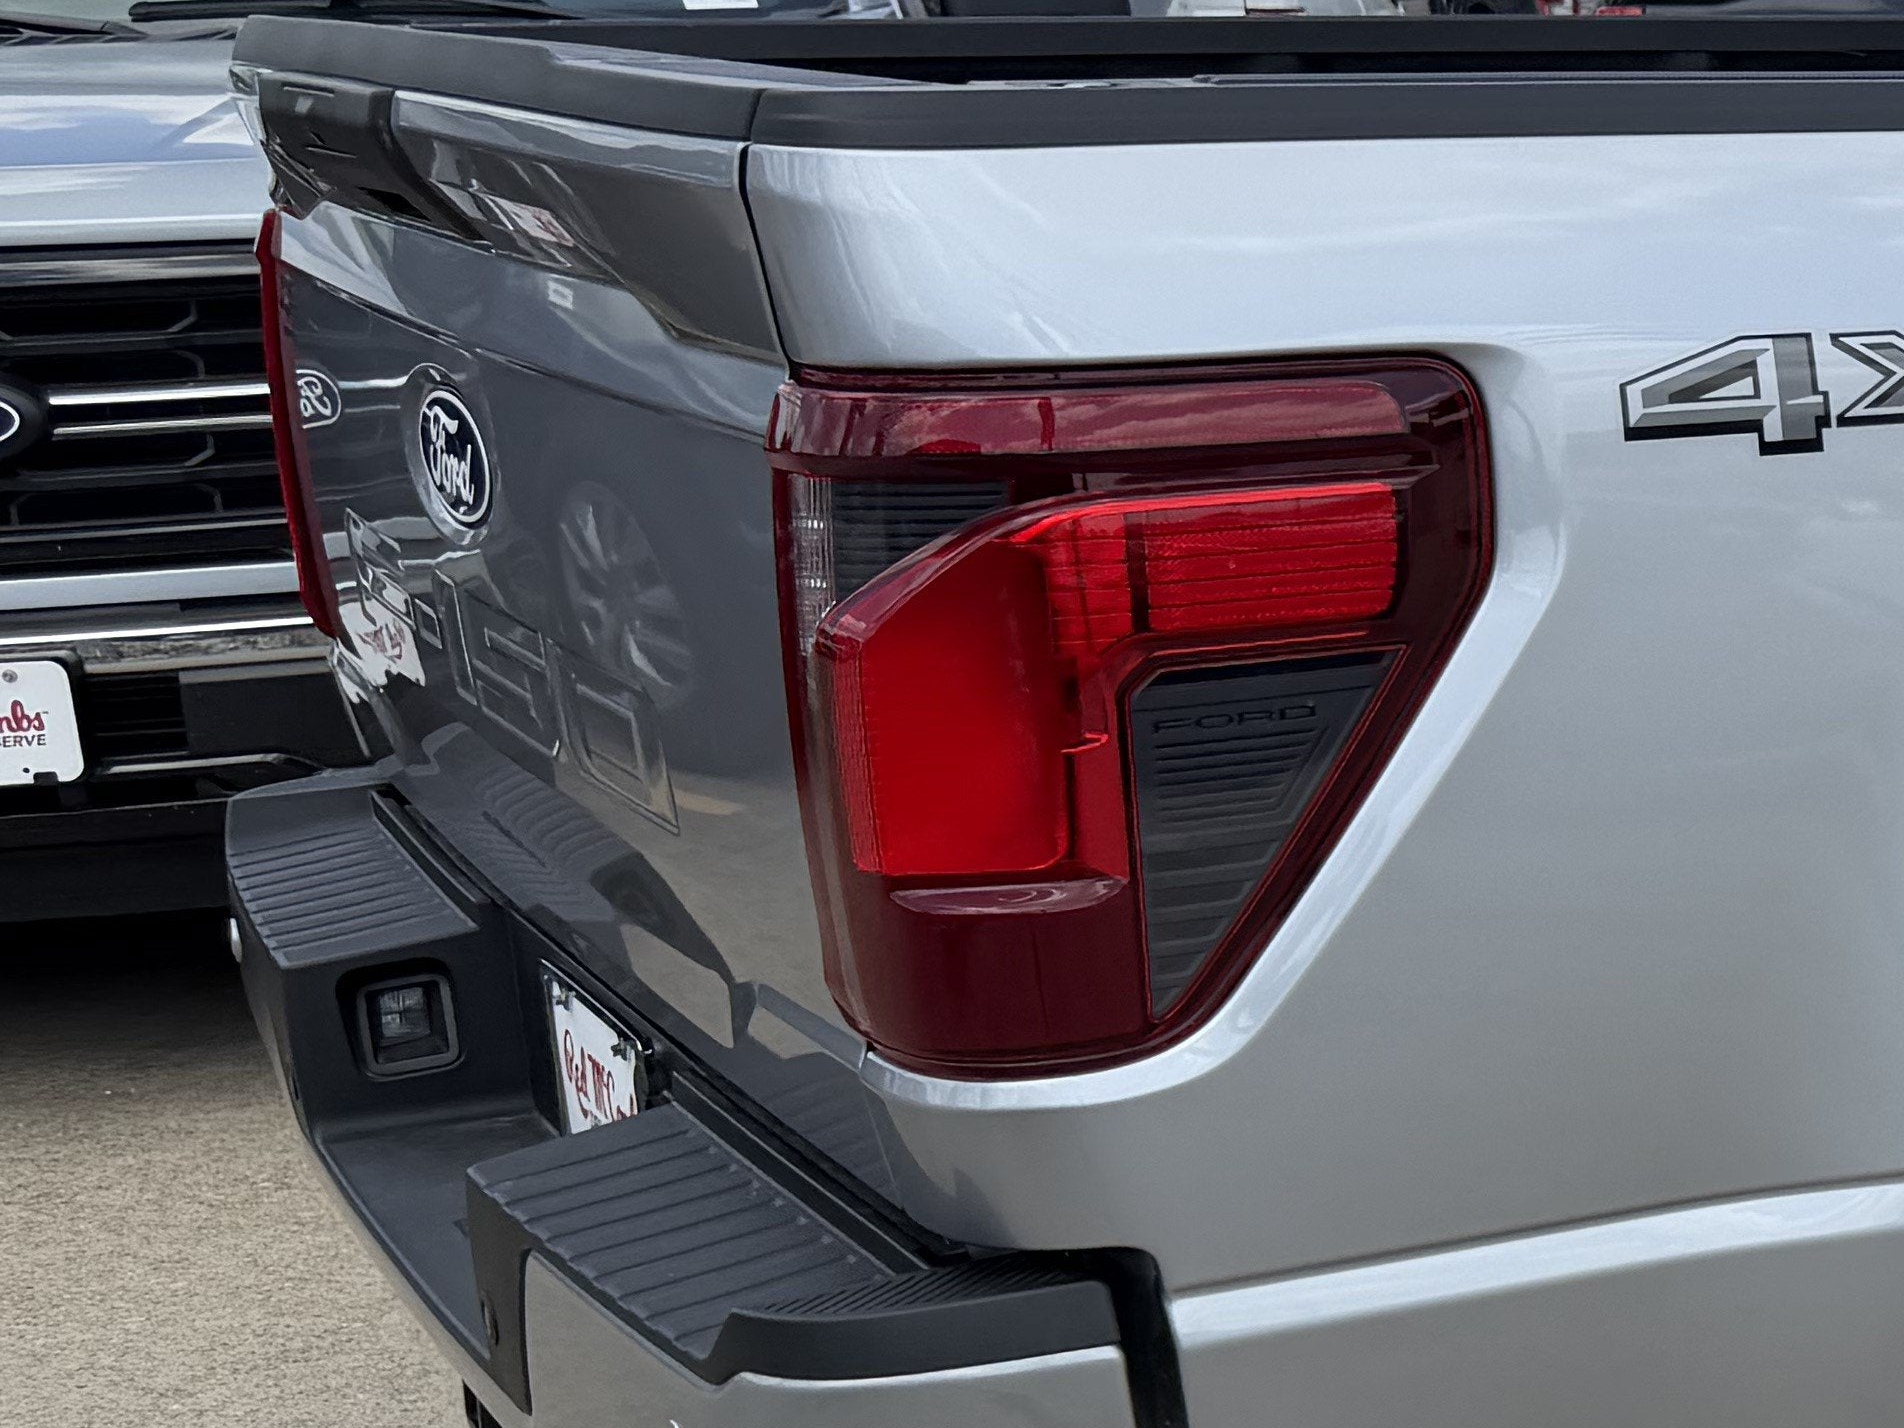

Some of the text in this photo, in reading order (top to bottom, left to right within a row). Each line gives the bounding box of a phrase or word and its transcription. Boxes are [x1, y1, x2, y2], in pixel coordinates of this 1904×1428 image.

[422, 405, 475, 506] Ford
[1151, 705, 1317, 735] FORD
[0, 734, 46, 747] ERVE
